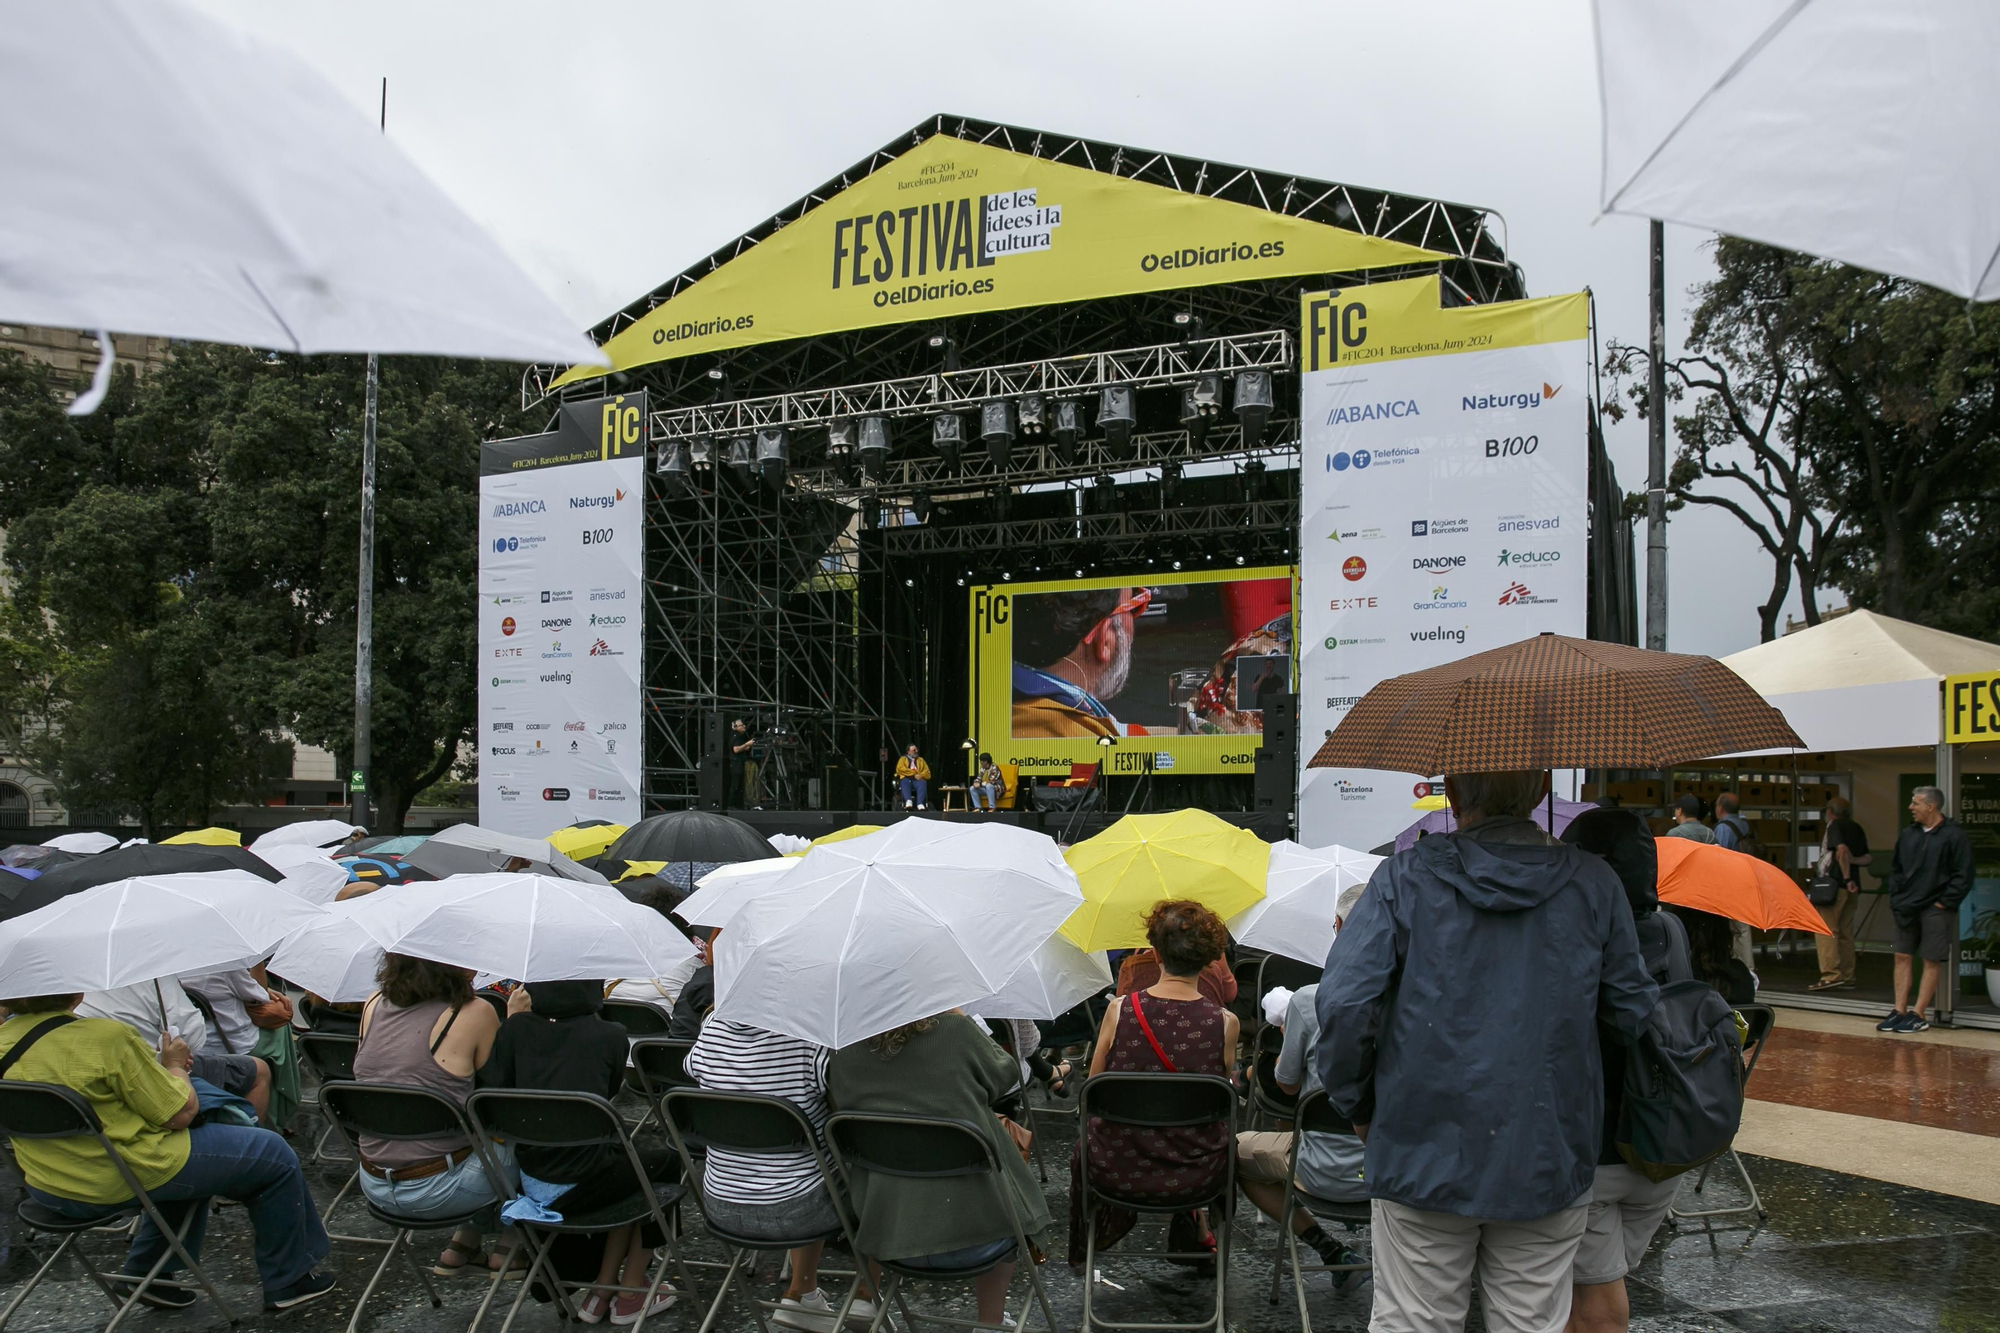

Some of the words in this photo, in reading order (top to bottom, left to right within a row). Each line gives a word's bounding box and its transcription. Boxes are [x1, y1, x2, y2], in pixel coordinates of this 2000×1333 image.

[958, 168, 978, 180] 2024
[987, 194, 1010, 212] de
[1013, 191, 1037, 208] les
[986, 214, 1033, 233] idees
[1036, 209, 1041, 226] i
[1045, 207, 1061, 225] la
[832, 195, 995, 290] FESTIVAL
[985, 232, 1051, 253] cultura
[1441, 338, 1466, 351] Juny
[1467, 334, 1493, 347] 2024
[1462, 392, 1540, 411] Naturgy
[1373, 446, 1420, 458] Telefónica
[1485, 435, 1539, 458] B100
[569, 494, 615, 509] Naturgy
[1498, 515, 1560, 532] anesvad
[582, 528, 614, 545] B100
[1413, 555, 1467, 569] DANONE
[1512, 551, 1560, 563] educo
[589, 589, 626, 601] anesvad
[1330, 597, 1378, 610] EXTE
[597, 615, 626, 625] educo
[1410, 626, 1466, 644] vueling
[495, 648, 522, 657] EXTE
[540, 671, 571, 685] vueling
[496, 747, 516, 755] FOCUS
[1115, 752, 1159, 771] FESTIVAL
